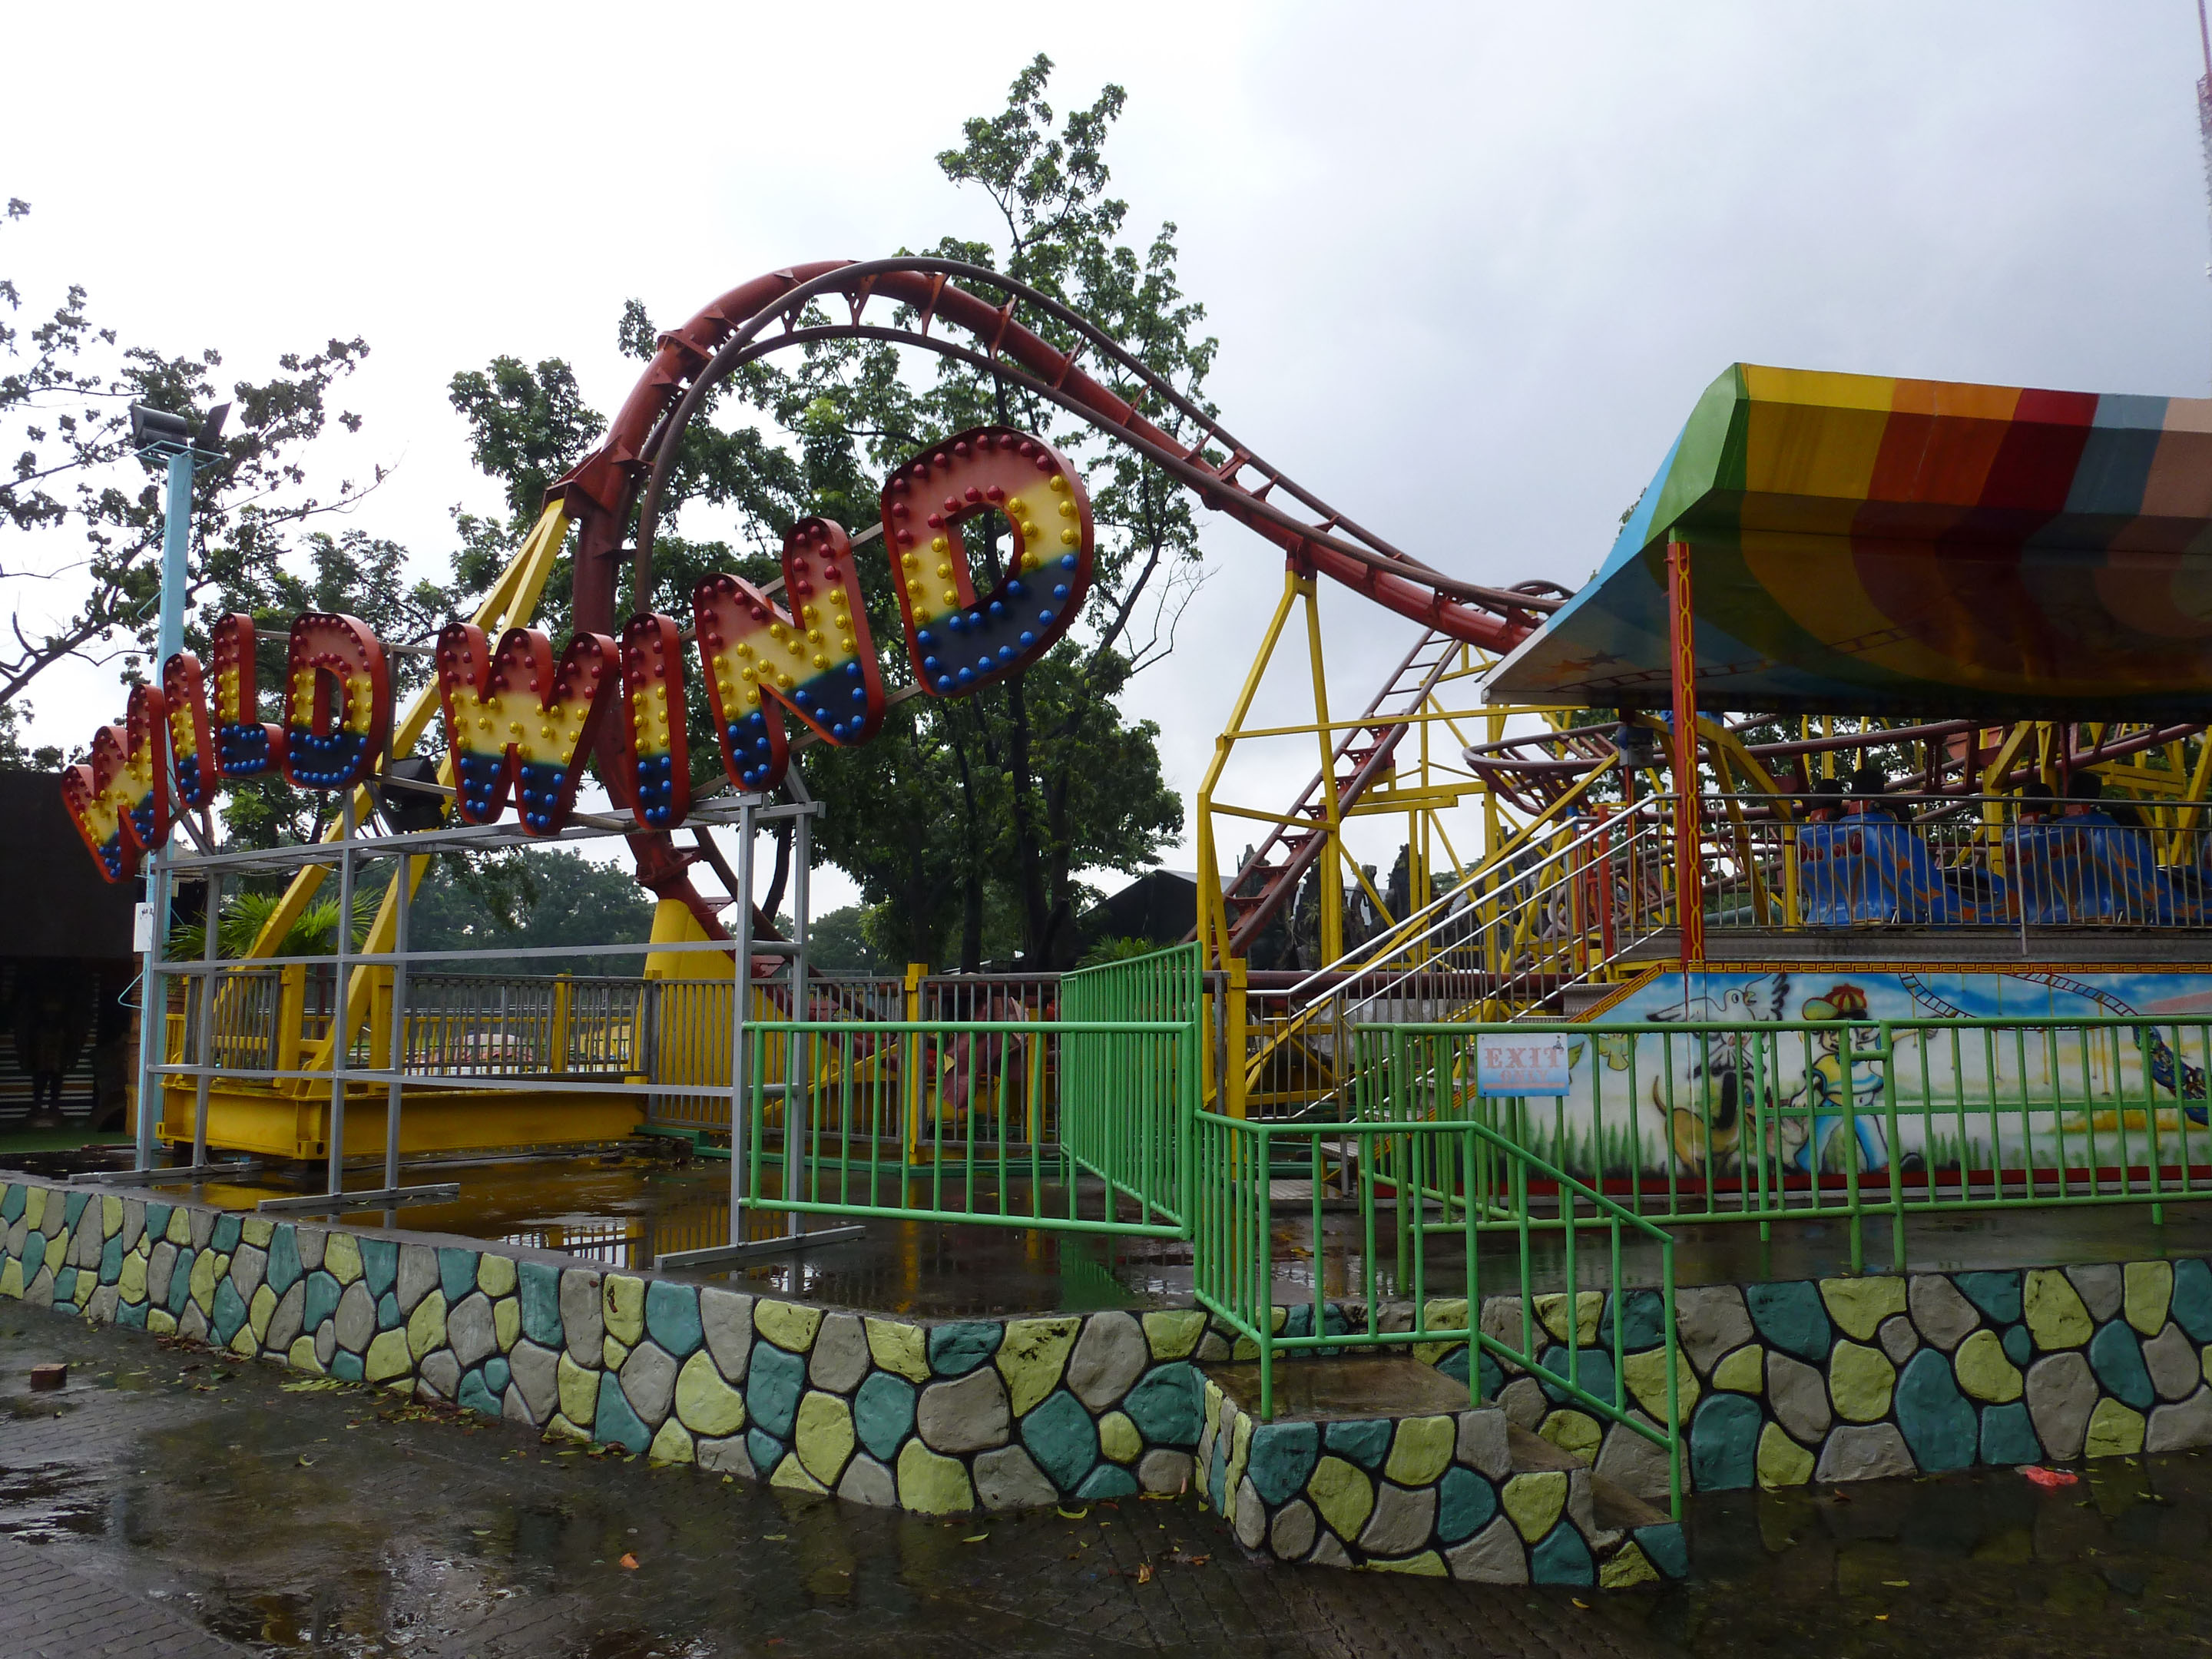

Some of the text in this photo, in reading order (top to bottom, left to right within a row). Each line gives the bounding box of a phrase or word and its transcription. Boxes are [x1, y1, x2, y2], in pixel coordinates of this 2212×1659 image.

[61, 426, 1094, 884] WILD WIND
[1484, 1047, 1564, 1068] EXIT
[1499, 1069, 1548, 1082] ONLY
